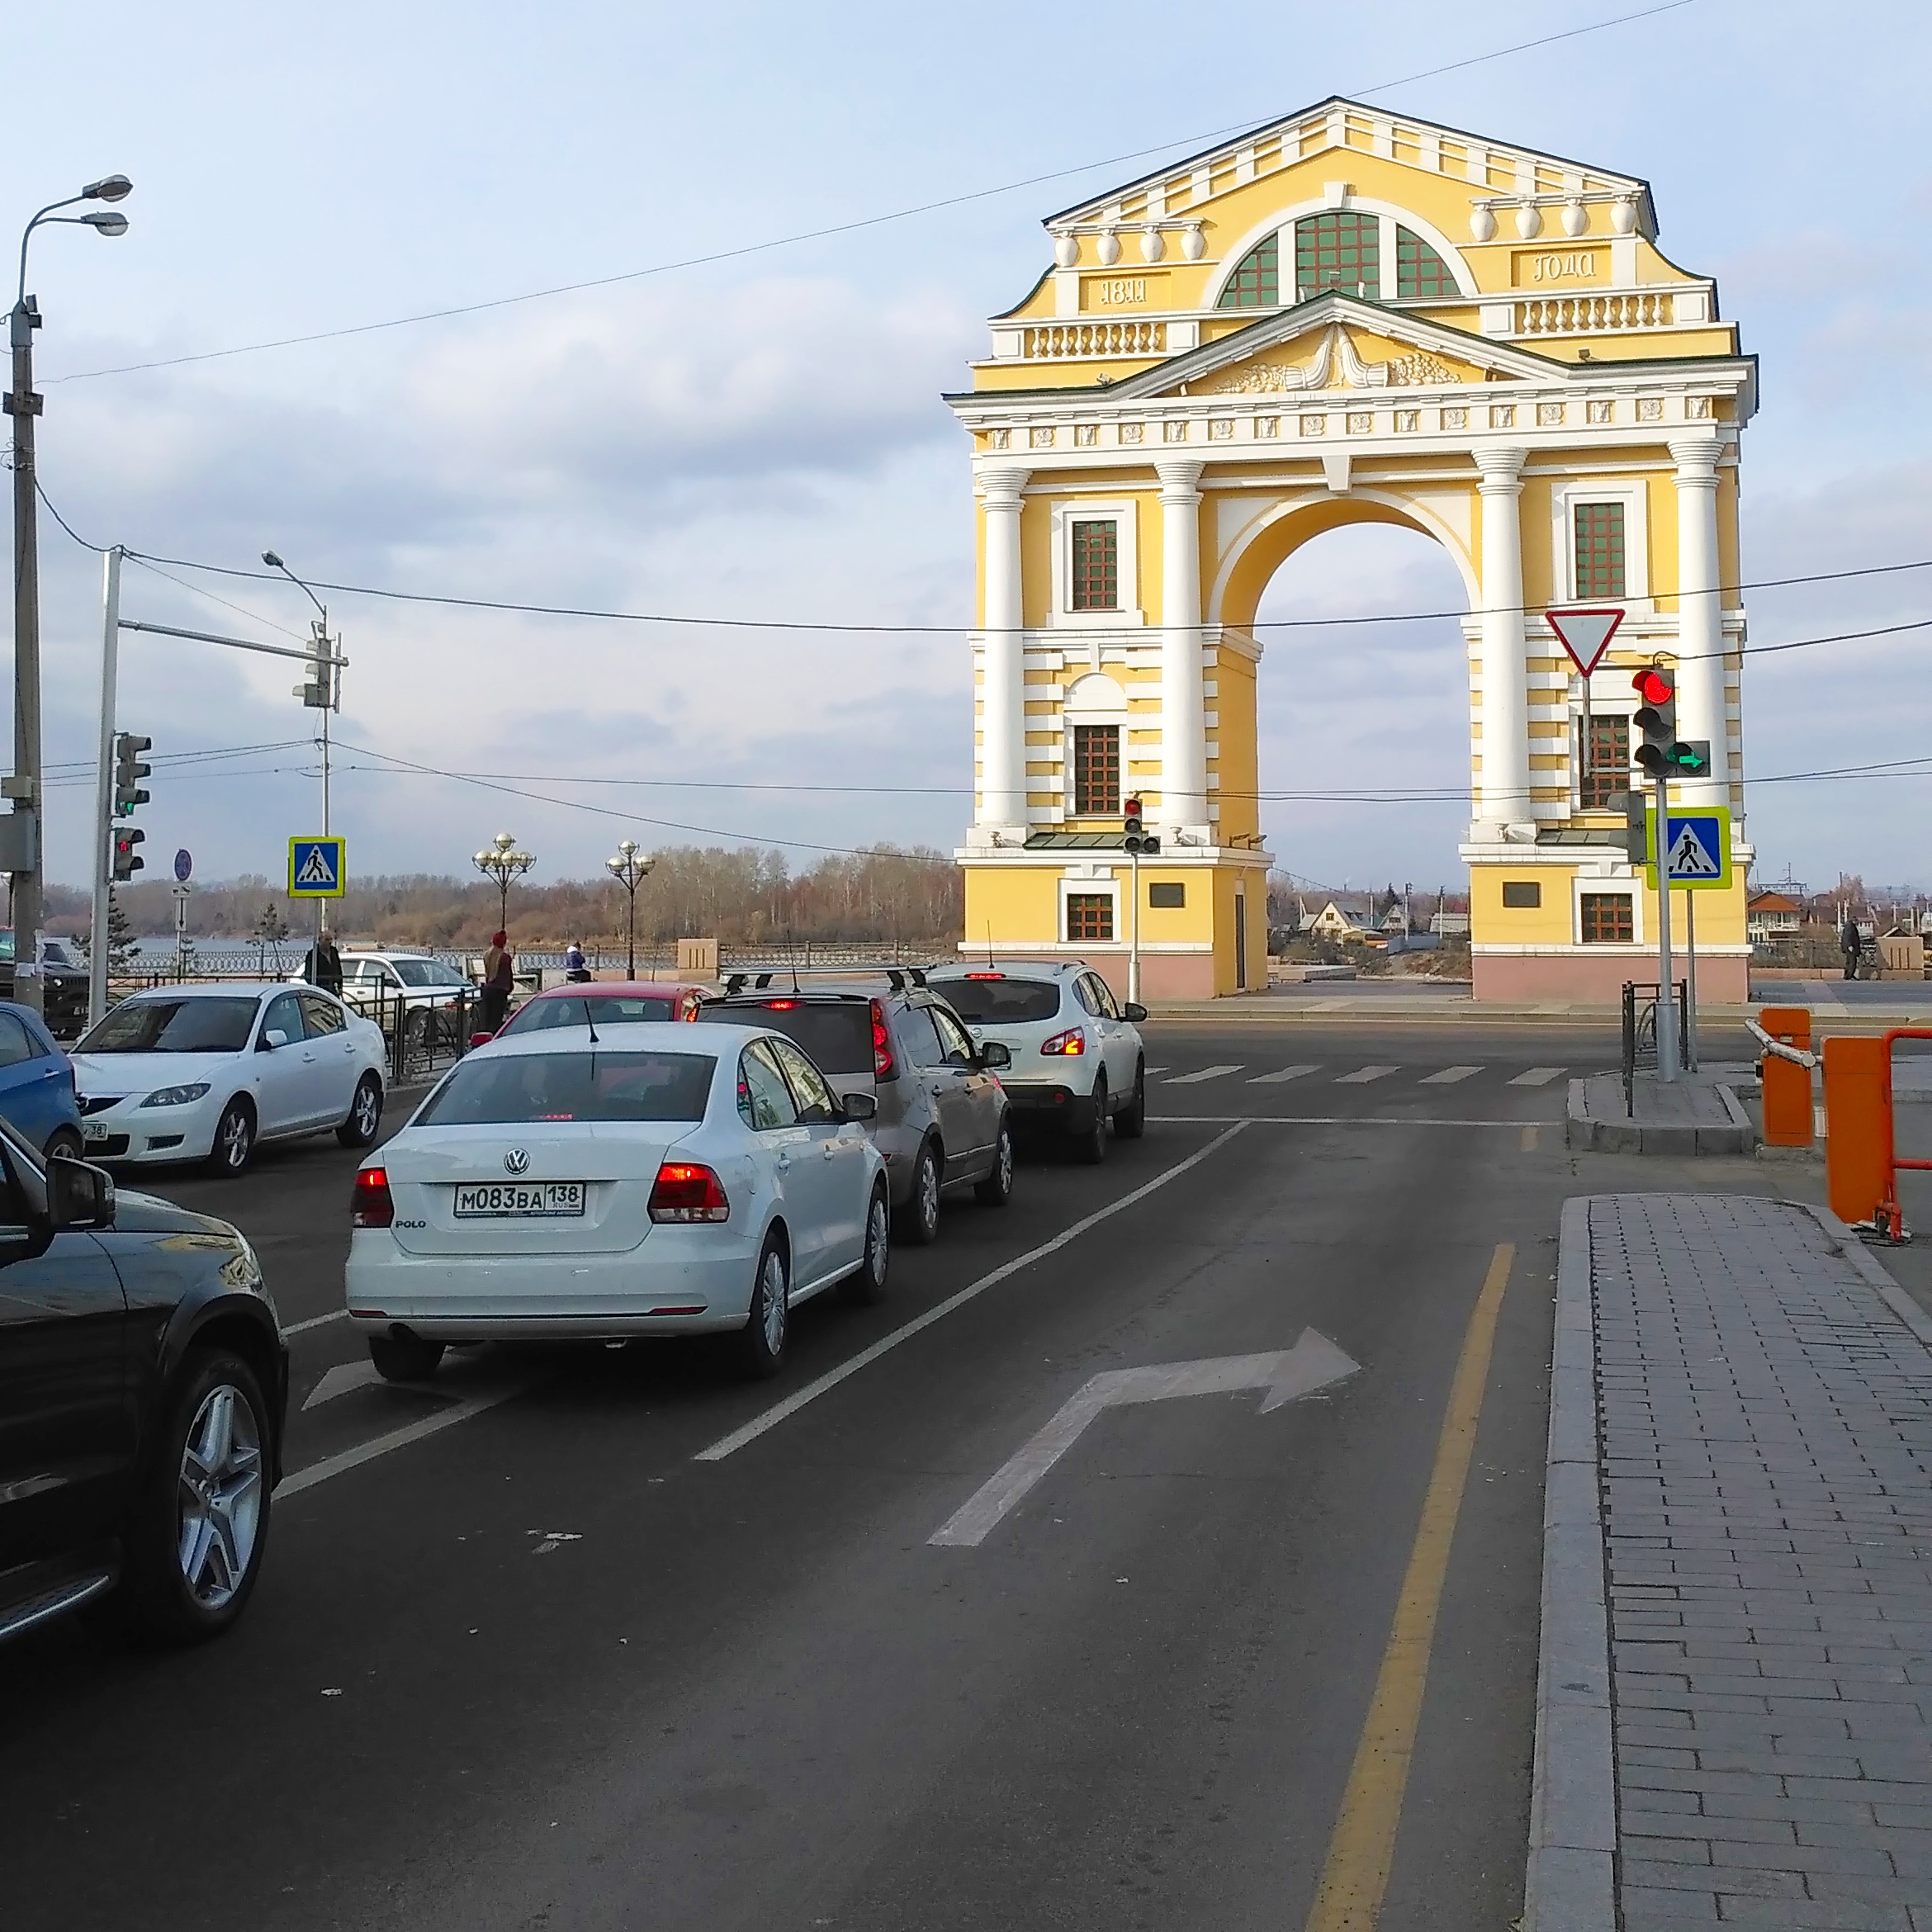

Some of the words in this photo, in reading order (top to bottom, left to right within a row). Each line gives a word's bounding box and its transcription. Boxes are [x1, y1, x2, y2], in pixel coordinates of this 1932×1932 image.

[1100, 278, 1147, 305] 1811
[547, 1186, 579, 1202] 138
[395, 1220, 427, 1229] POLO
